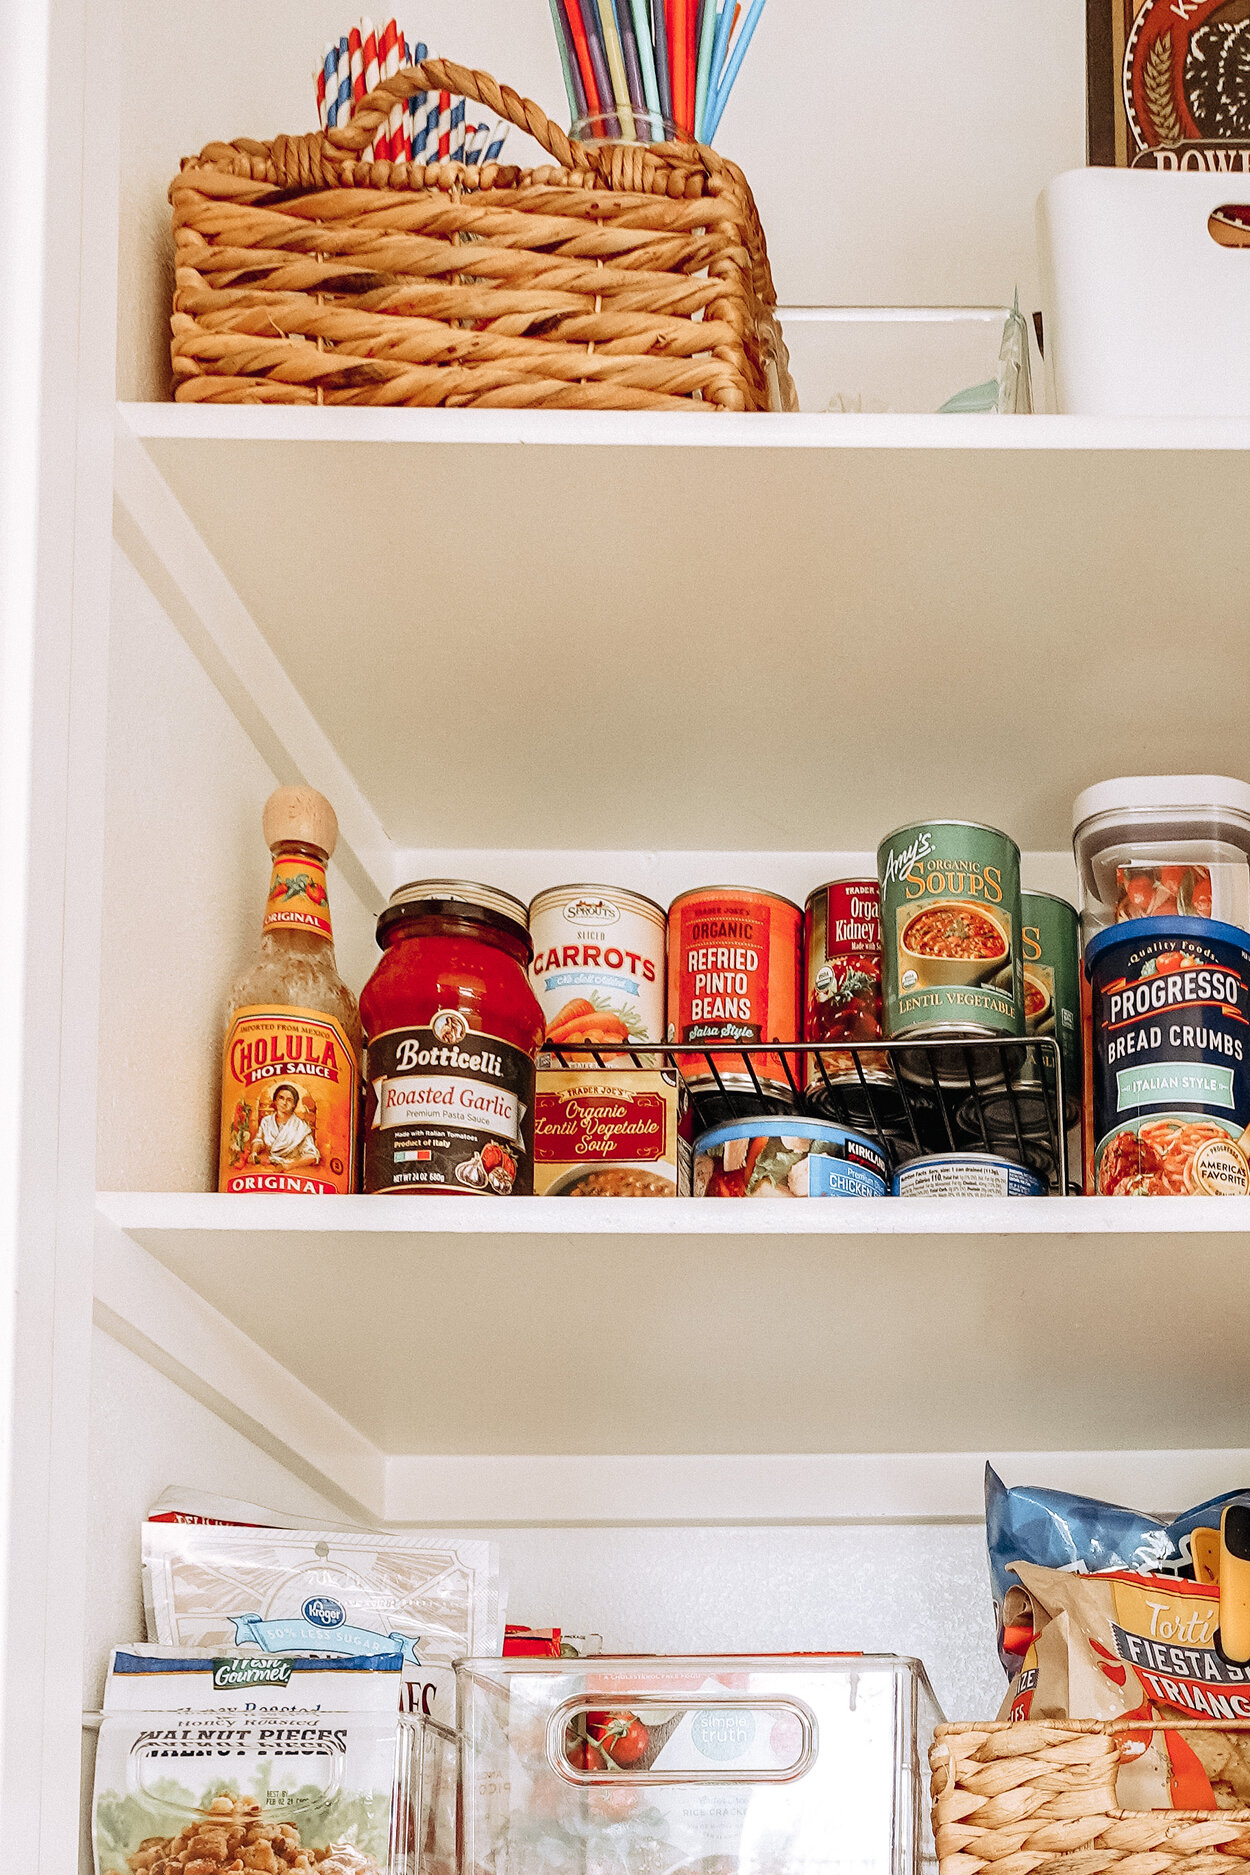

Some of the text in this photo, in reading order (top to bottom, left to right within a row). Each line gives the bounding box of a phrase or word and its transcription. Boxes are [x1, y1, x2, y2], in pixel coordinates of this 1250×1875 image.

[927, 859, 981, 873] ORGANIC
[905, 861, 1003, 903] SOUPS
[851, 896, 880, 921] Orga
[692, 921, 753, 941] ORGANIC
[835, 918, 875, 942] Kidney
[533, 945, 657, 983] CARROTS
[688, 947, 759, 973] REFRIED
[695, 973, 748, 996] PINTO
[691, 997, 751, 1021] BEANS
[899, 992, 1016, 1020] LENTIL VEGETABLE
[1110, 971, 1239, 1023] PROGRESSO
[689, 1022, 754, 1040] Salsa Style
[1107, 1024, 1244, 1065] BREAD CRUMBS
[230, 1034, 339, 1084] CHOLULA
[395, 1038, 503, 1078] Botticelli
[251, 1063, 331, 1082] HOT SAUCE
[567, 1086, 600, 1098] TRADER
[1132, 1078, 1218, 1093] ITALIAN STYLE
[386, 1086, 513, 1120] Roasted Garlic
[566, 1100, 628, 1121] Organic
[534, 1117, 661, 1140] Lentil Vegetable
[574, 1134, 618, 1158] Soup
[1201, 1170, 1246, 1188] FAVORITE
[308, 1600, 342, 1626] Kroger
[1145, 1599, 1219, 1644] Torti
[1125, 1633, 1223, 1682] FIESTA
[701, 1728, 748, 1743] truth
